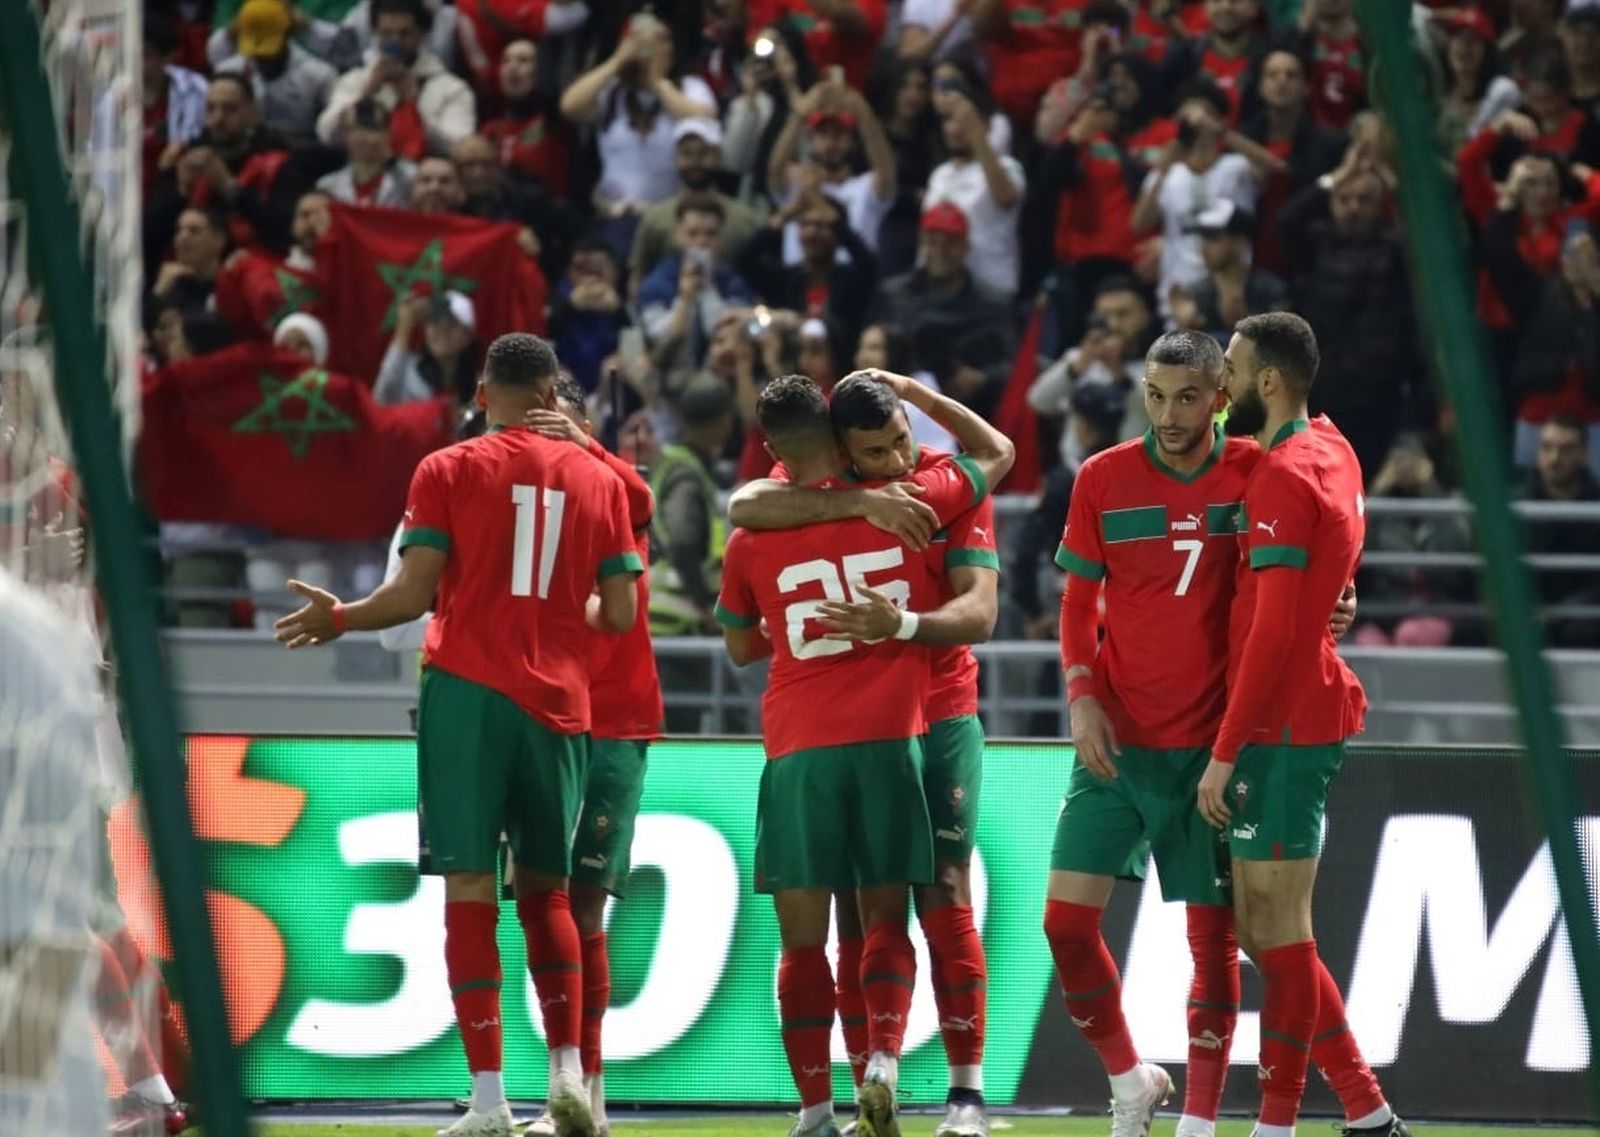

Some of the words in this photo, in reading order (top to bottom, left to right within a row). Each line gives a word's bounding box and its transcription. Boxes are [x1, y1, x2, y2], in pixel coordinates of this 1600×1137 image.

[511, 484, 566, 600] 11
[1171, 521, 1197, 531] PUMA
[1173, 539, 1204, 596] 7
